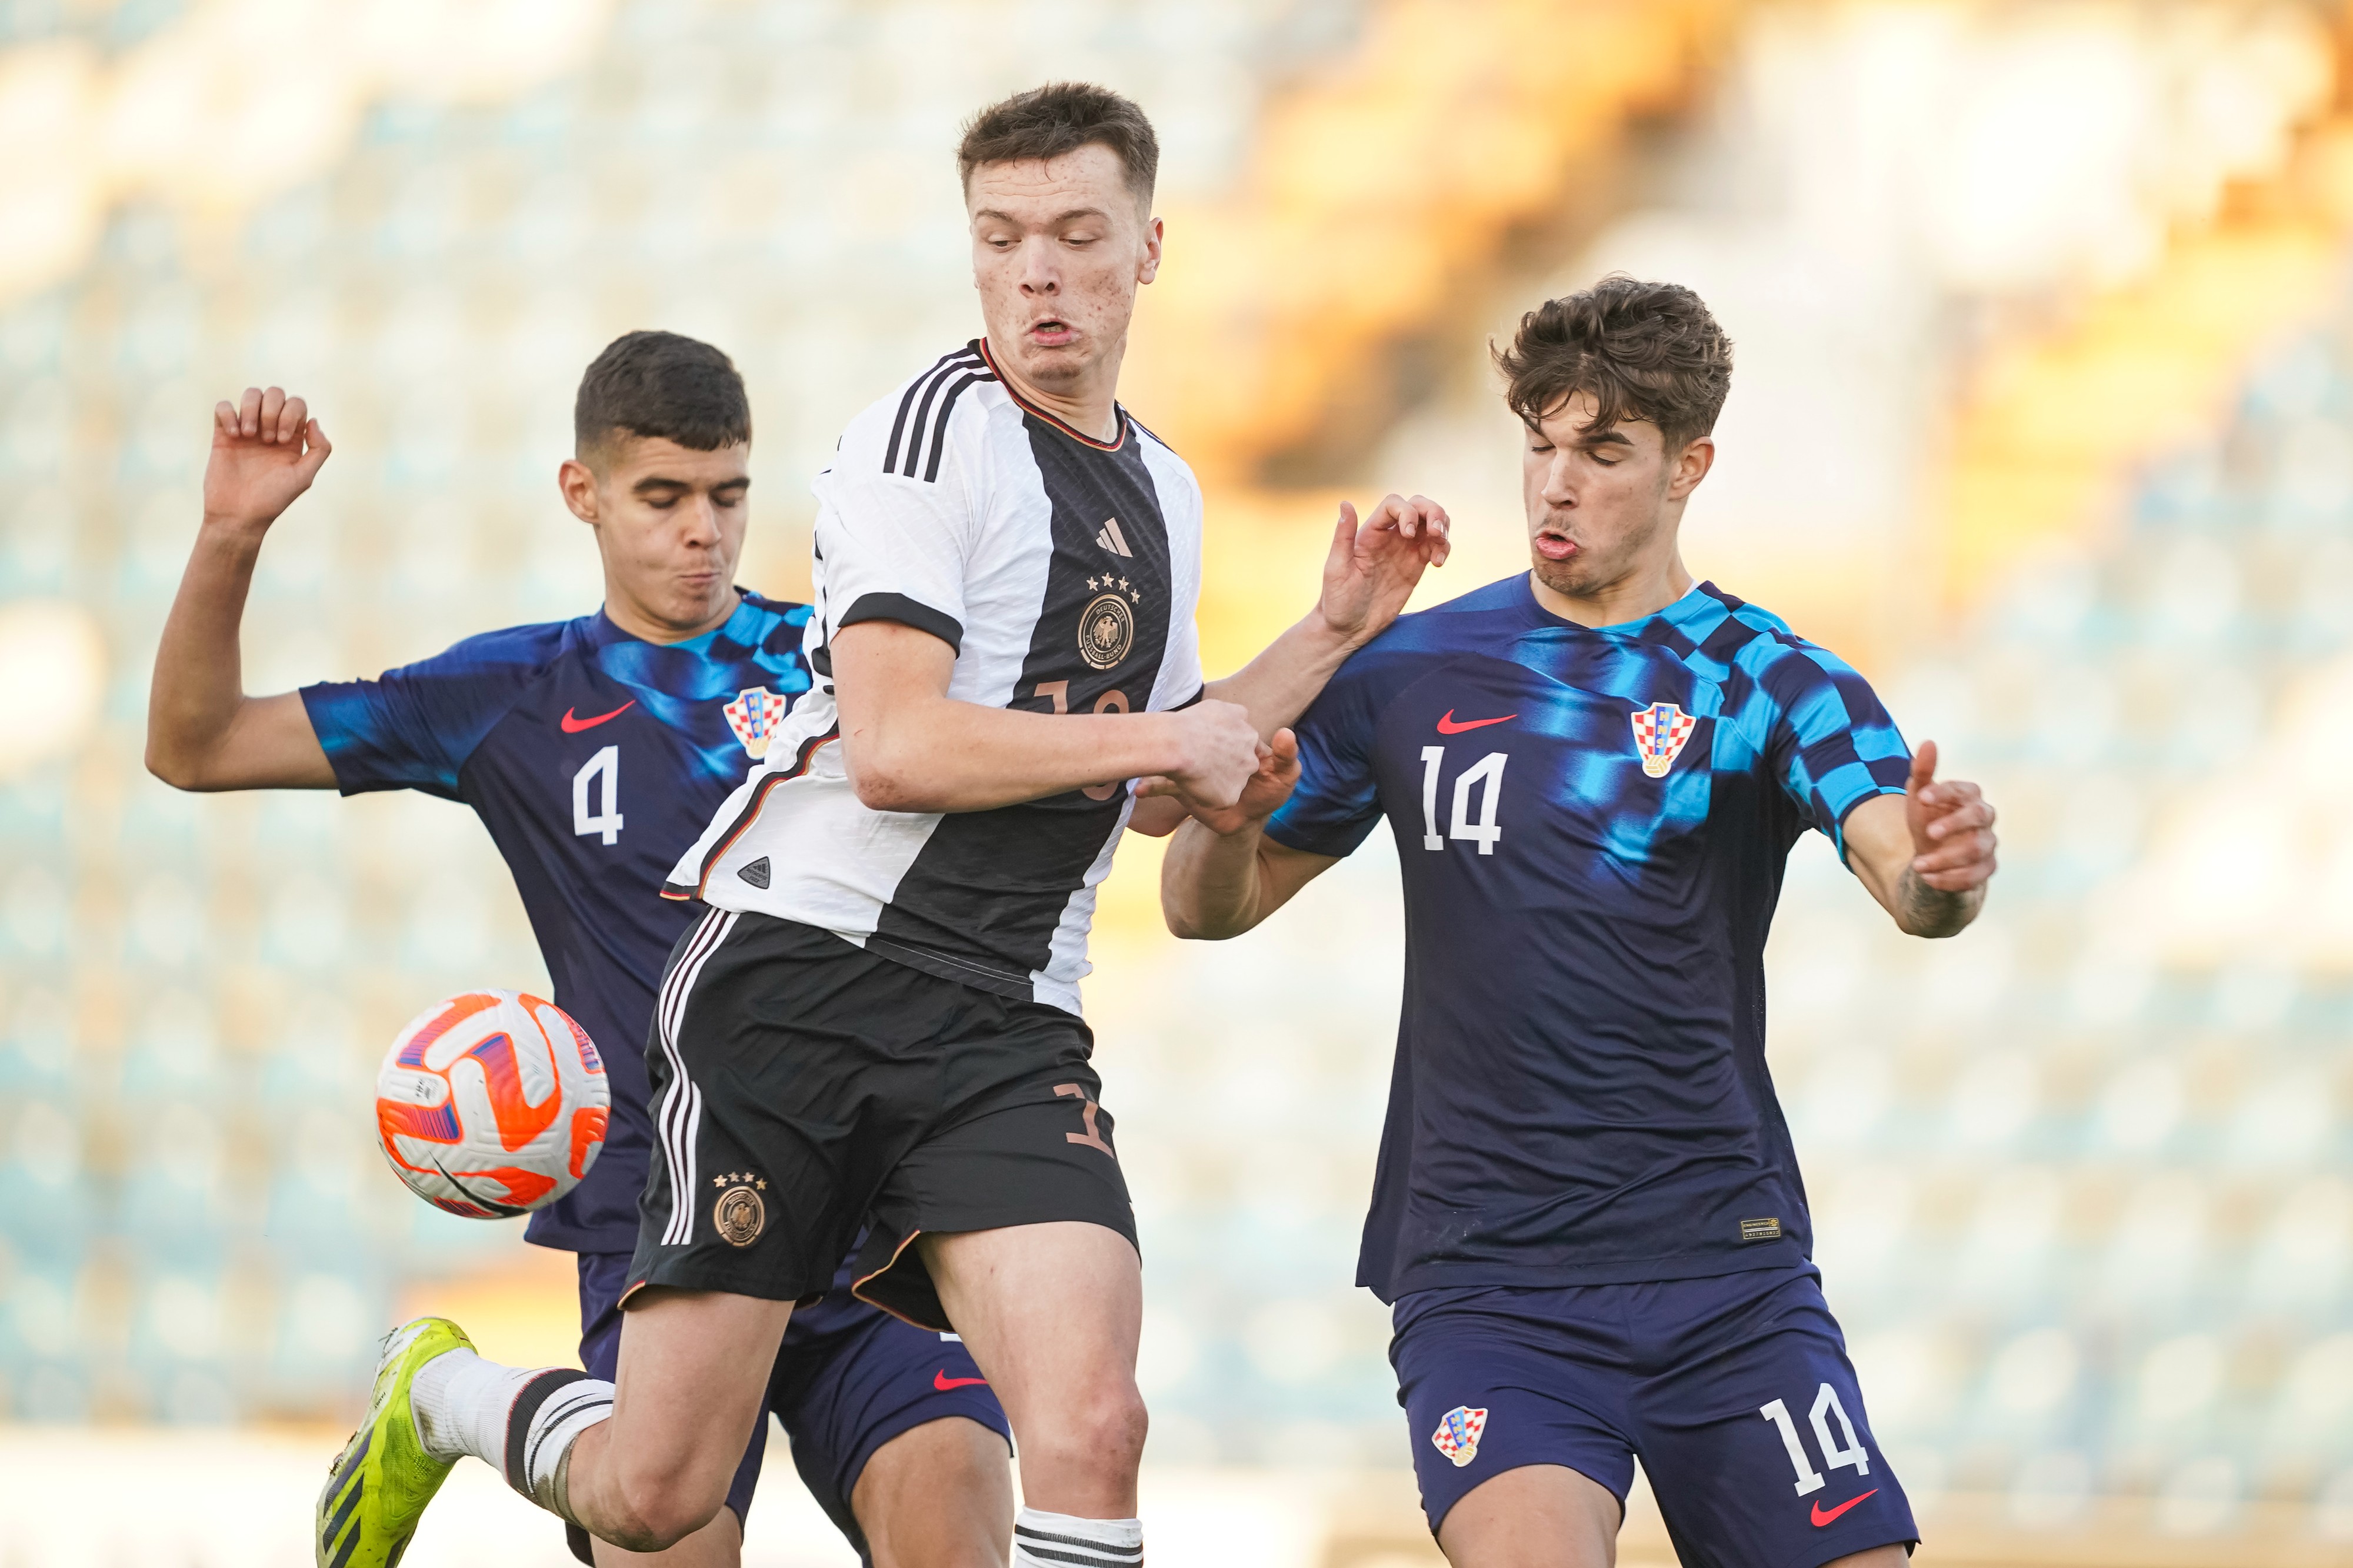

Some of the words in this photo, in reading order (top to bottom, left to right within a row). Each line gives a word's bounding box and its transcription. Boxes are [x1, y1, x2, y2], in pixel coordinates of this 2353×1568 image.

[1096, 604, 1125, 622] DEUTSCHER
[1656, 711, 1670, 749] HNS
[572, 745, 624, 845] 4
[1420, 745, 1509, 855] 14
[1759, 1382, 1870, 1497] 14
